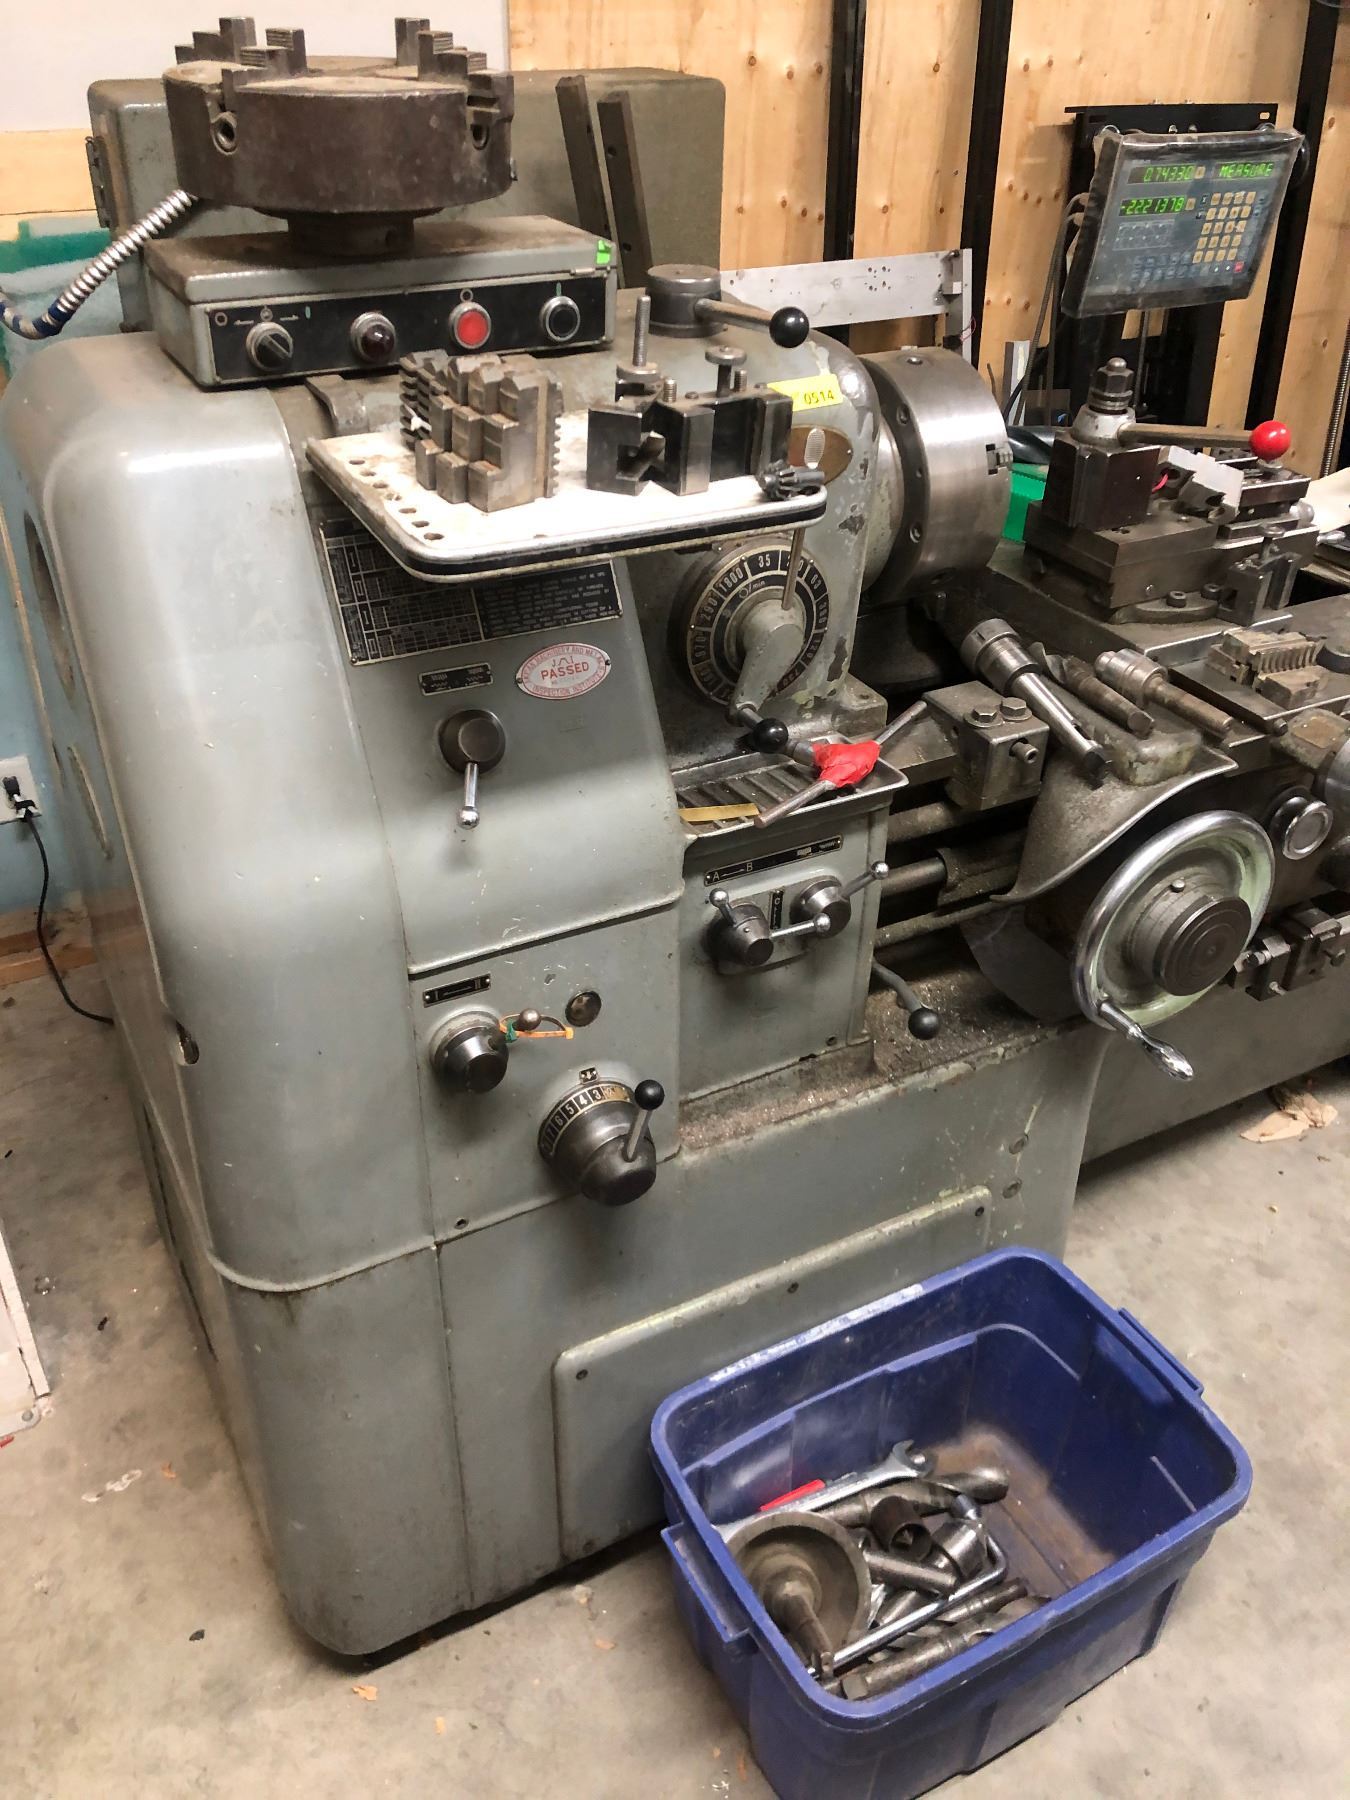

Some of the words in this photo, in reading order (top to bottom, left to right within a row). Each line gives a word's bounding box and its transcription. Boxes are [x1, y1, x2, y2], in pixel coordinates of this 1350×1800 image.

[758, 553, 771, 568] 35
[719, 567, 743, 592] 1800
[540, 661, 590, 681] PASSED
[712, 871, 720, 881] A
[746, 863, 753, 872] B
[565, 1103, 575, 1115] 5
[578, 1094, 588, 1105] 4
[592, 1089, 602, 1100] 3
